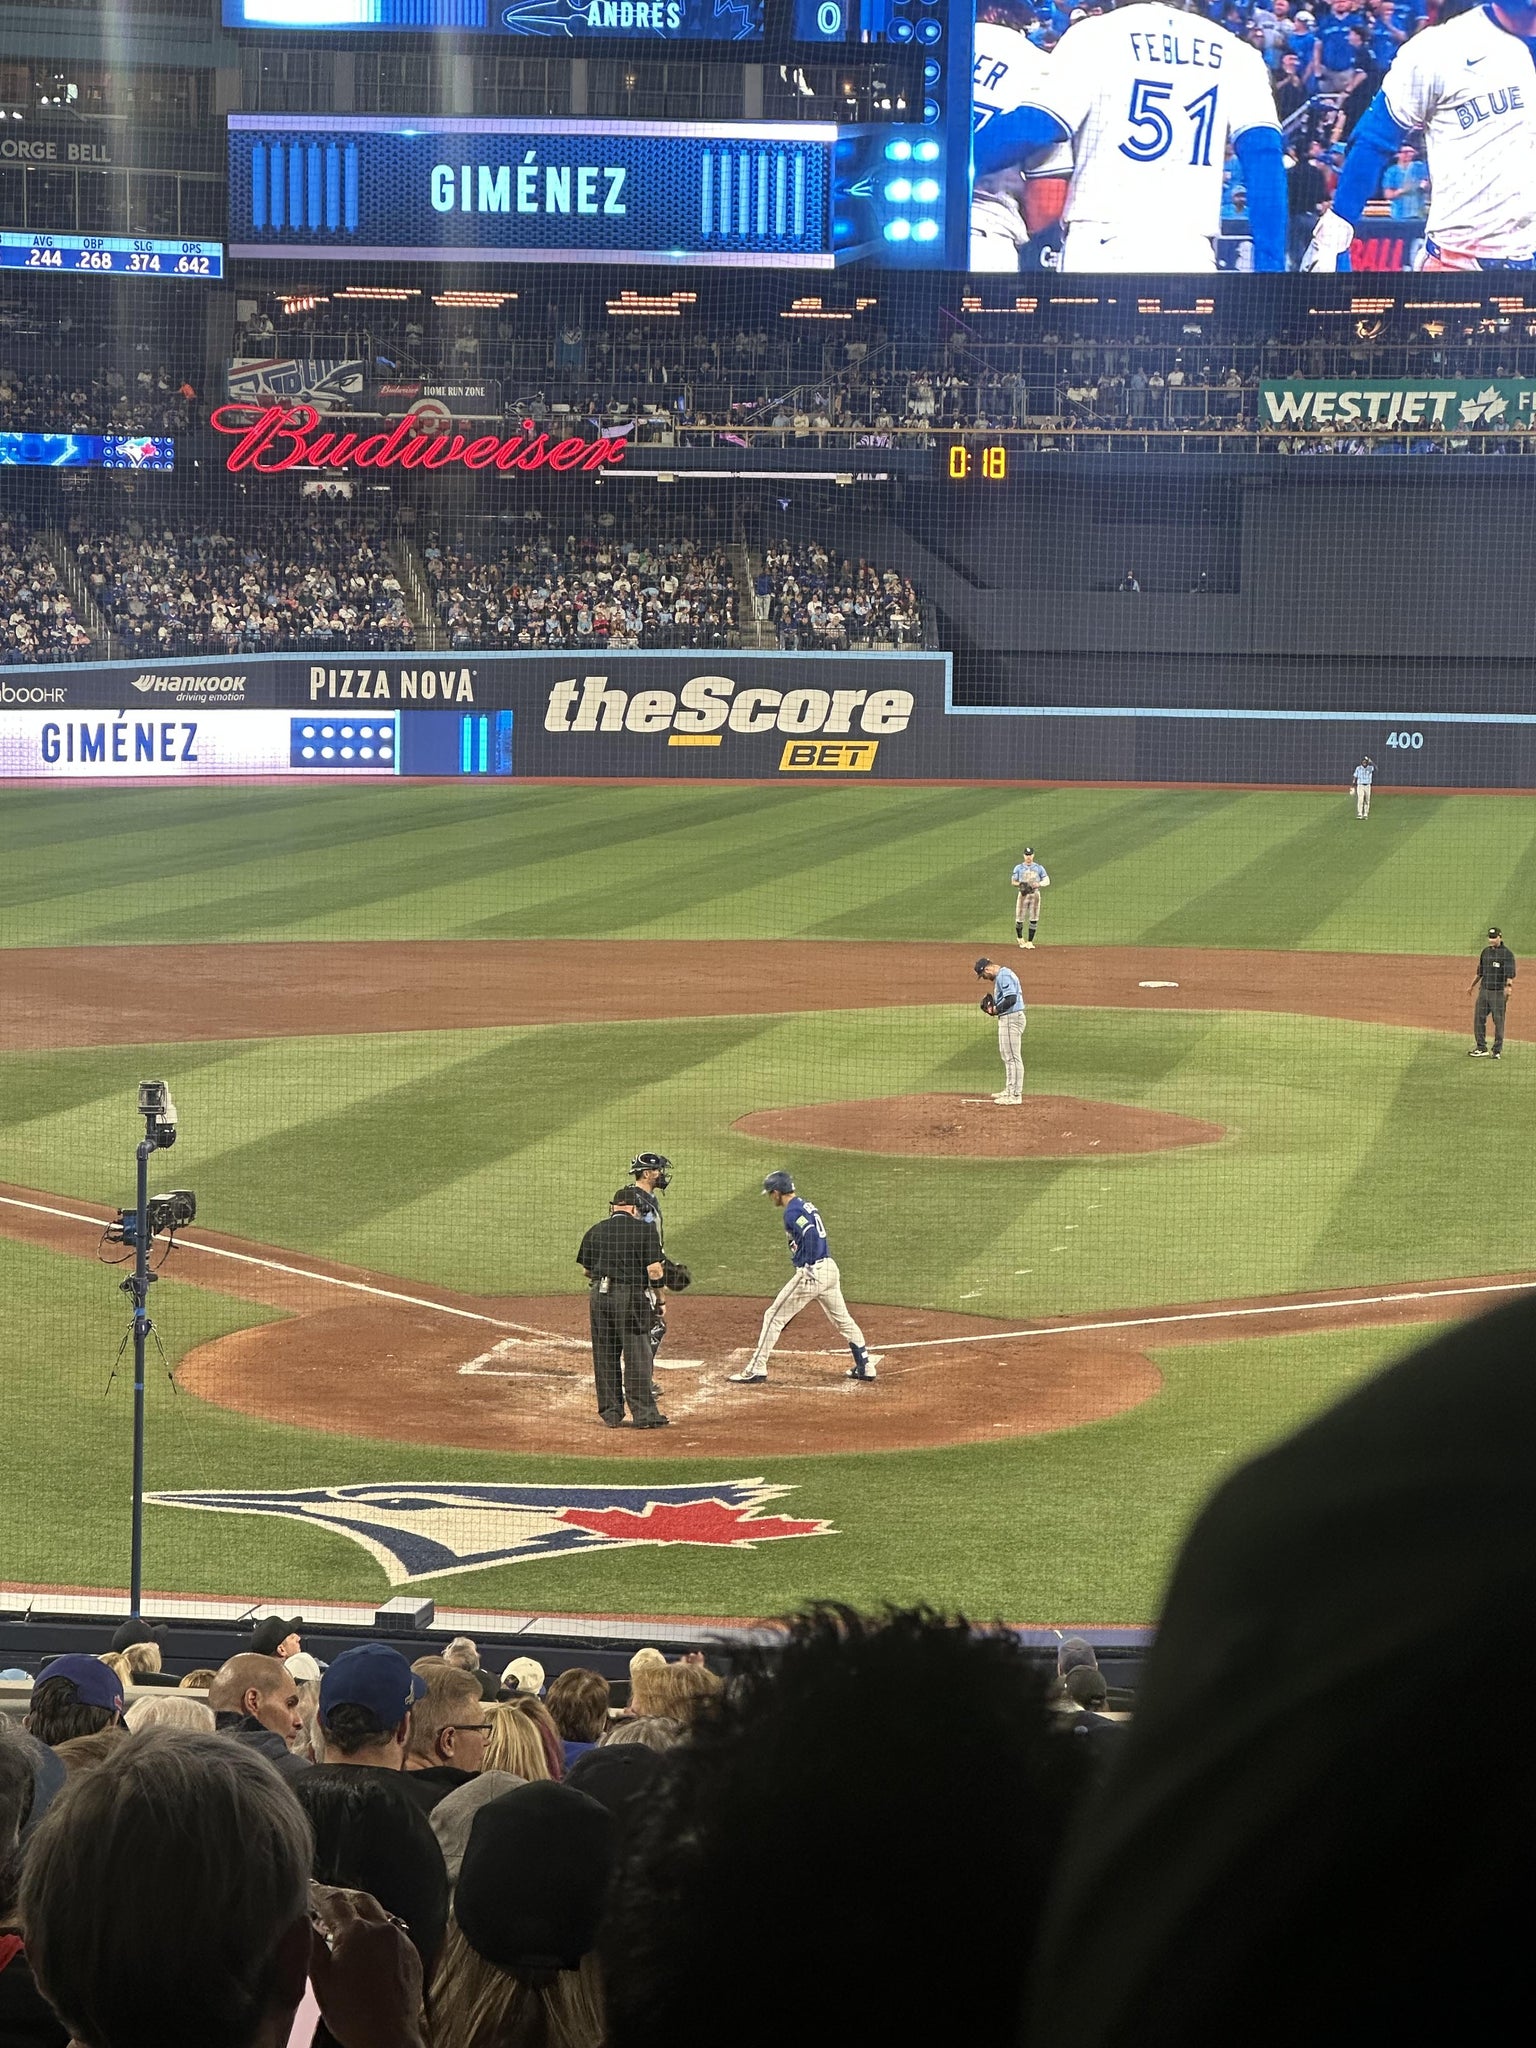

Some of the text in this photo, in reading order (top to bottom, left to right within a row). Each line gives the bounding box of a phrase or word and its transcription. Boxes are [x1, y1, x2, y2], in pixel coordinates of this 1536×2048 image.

[1130, 32, 1223, 69] FEBLES
[973, 54, 1009, 90] ER
[1118, 78, 1219, 167] 51
[1455, 86, 1524, 130] BLUE
[0, 139, 112, 163] ORGE BELL
[430, 150, 626, 214] GIMÉNEZ
[25, 249, 210, 274] .244 .268 .374 .642
[33, 235, 202, 254] AVG OBP SLG OPS
[424, 387, 446, 396] HOME
[448, 387, 463, 396] RUN
[465, 387, 485, 397] ZONE
[1264, 391, 1457, 429] WESTJET
[210, 403, 627, 472] Budweiser
[0, 681, 65, 702] booHR
[176, 692, 245, 703] driving emotion
[310, 666, 474, 702] PIZZA NOVA
[543, 676, 914, 733] theScore
[41, 709, 198, 763] GIMÉNEZ
[1385, 731, 1424, 749] 400
[788, 744, 870, 766] BET
